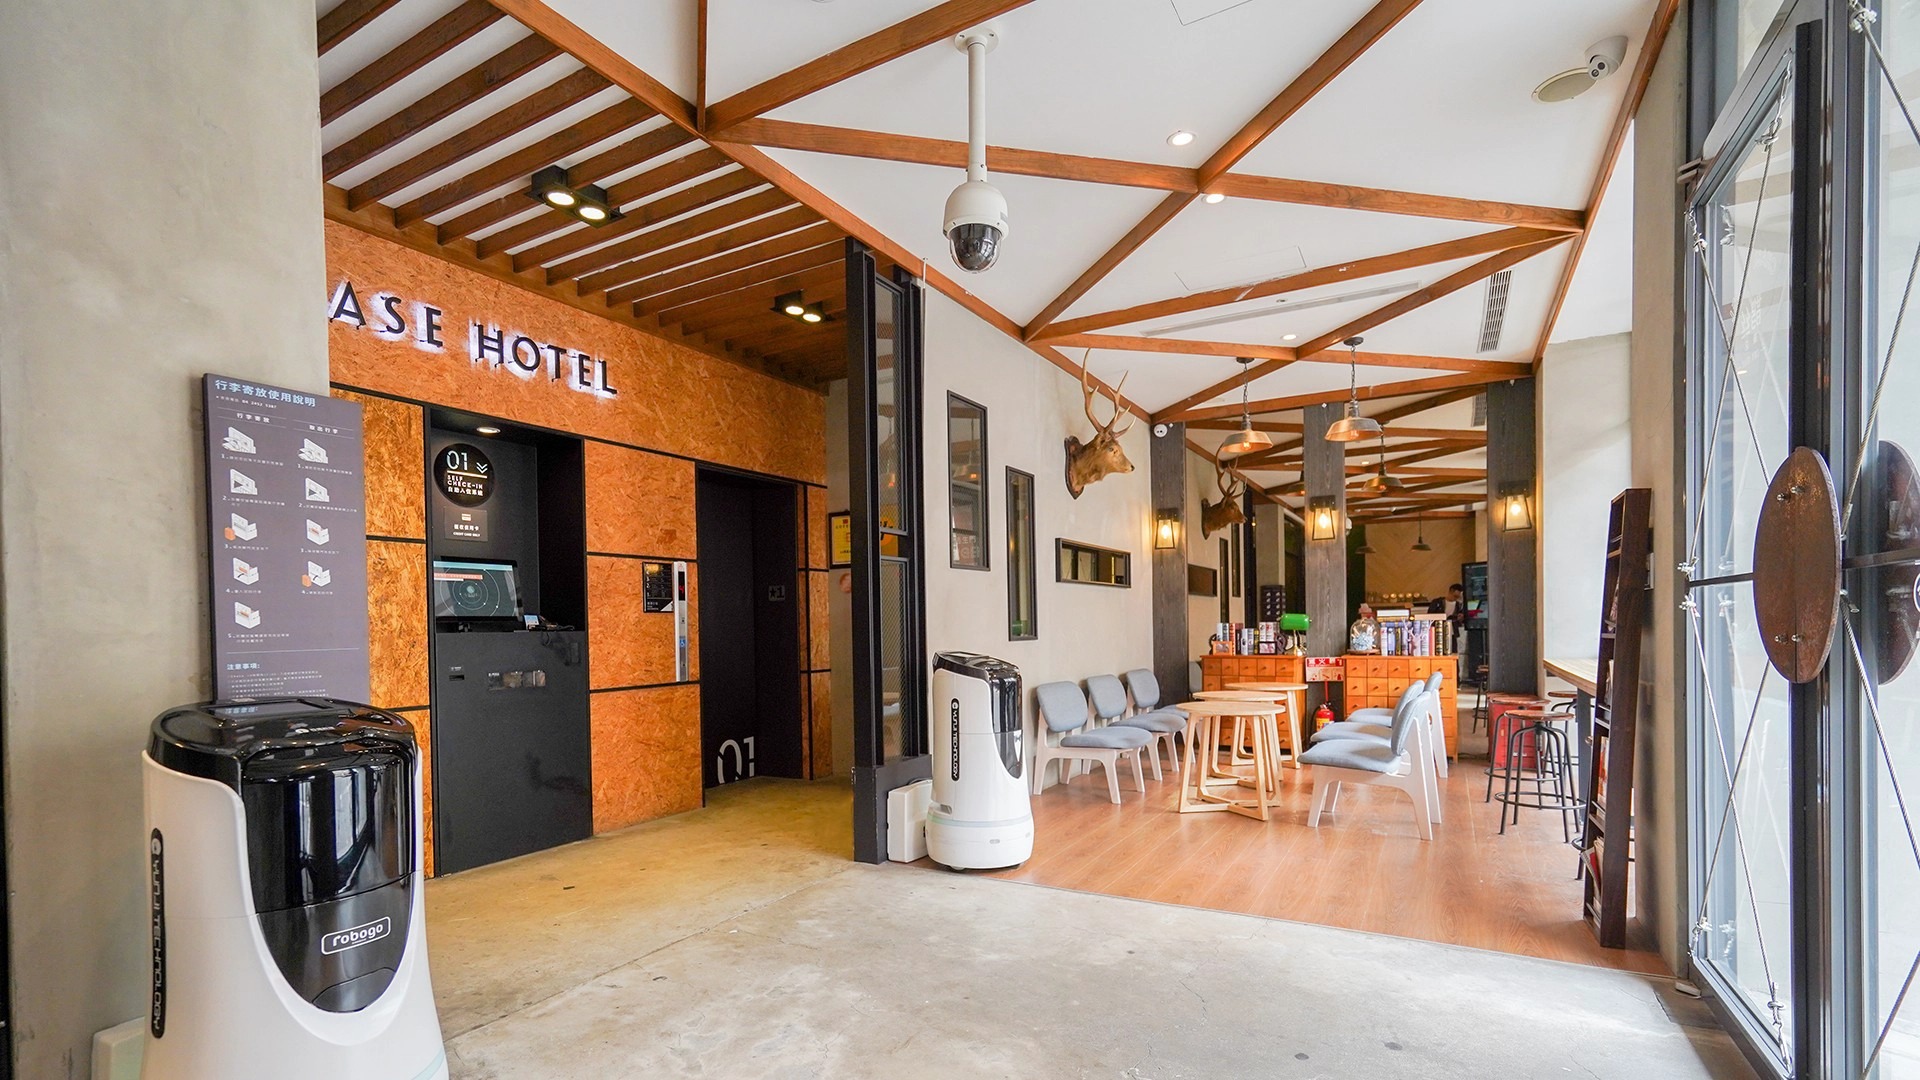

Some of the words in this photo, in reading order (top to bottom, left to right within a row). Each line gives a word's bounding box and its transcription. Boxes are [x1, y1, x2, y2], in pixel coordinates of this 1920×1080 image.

[330, 281, 443, 347] ASE
[474, 323, 618, 394] HOTEL
[215, 379, 316, 407] 行李寄放使用說明
[446, 450, 468, 470] 01
[447, 480, 483, 489] CHECK-IN
[717, 736, 755, 784] 01
[333, 924, 383, 946] robogo
[153, 914, 162, 1030] TECHNOLOGY
